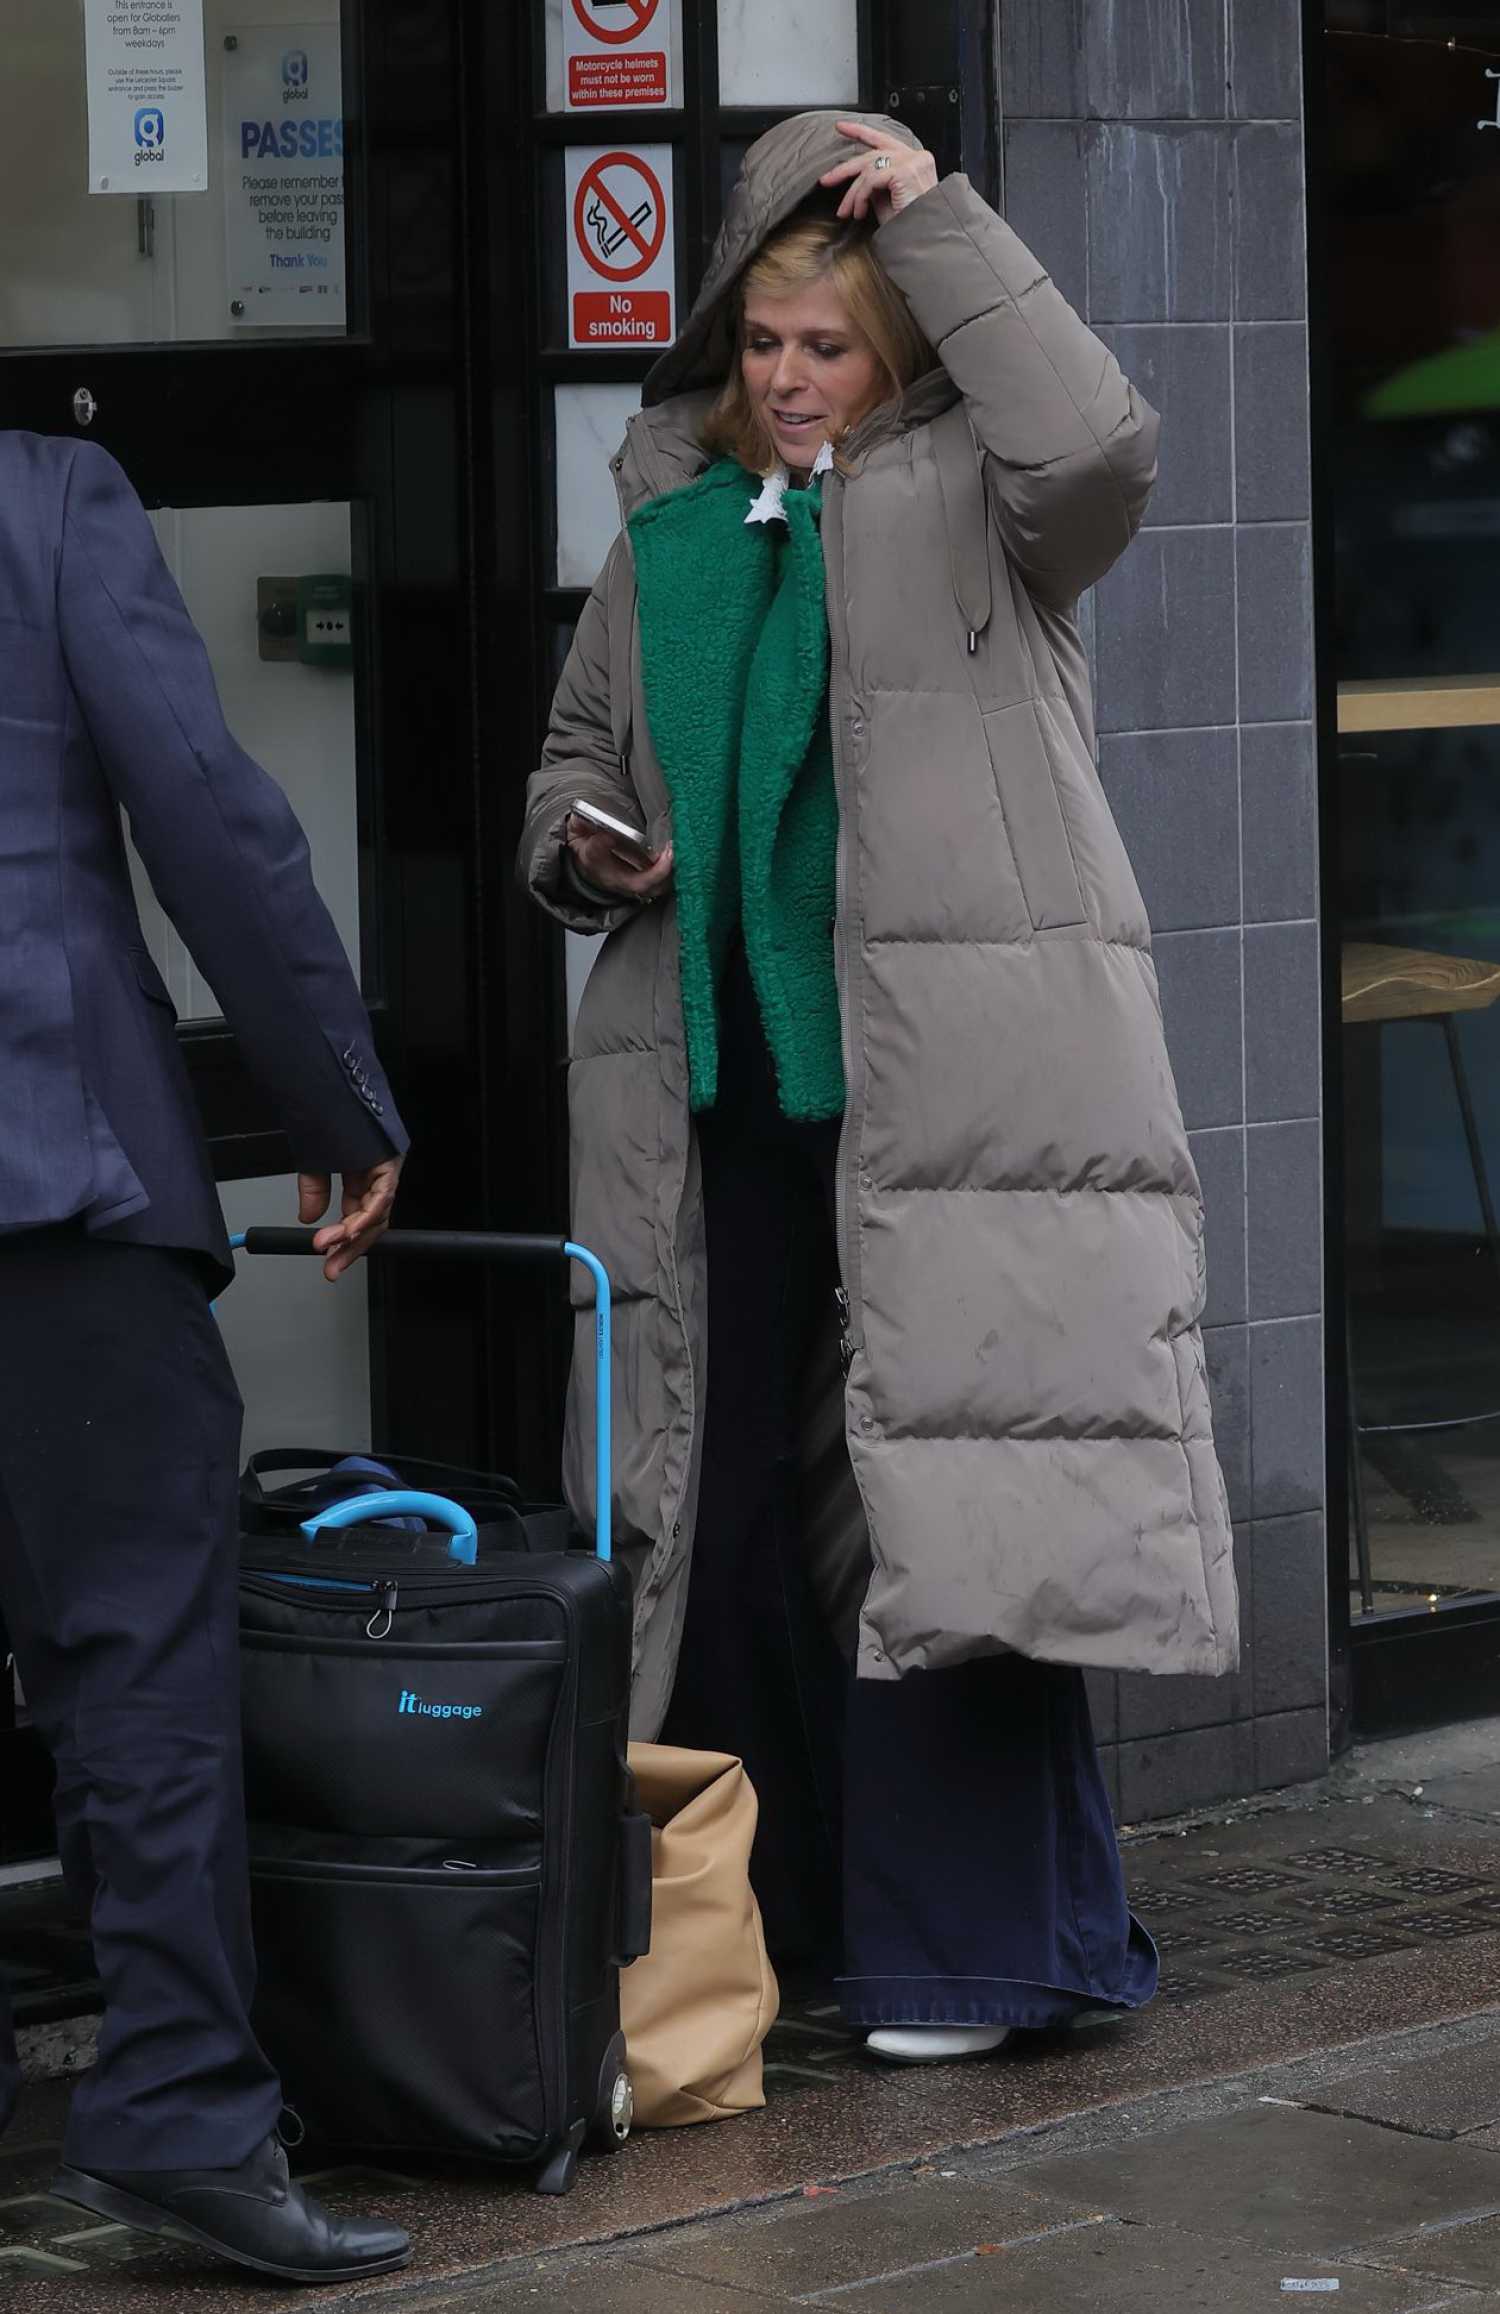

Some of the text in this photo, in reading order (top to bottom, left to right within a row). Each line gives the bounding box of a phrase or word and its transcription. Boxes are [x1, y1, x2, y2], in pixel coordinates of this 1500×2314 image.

[115, 0, 128, 9] This
[130, 0, 166, 9] entrance
[106, 14, 128, 25] open
[130, 13, 140, 21] for
[113, 26, 132, 35] from
[133, 25, 151, 35] 8am
[159, 26, 176, 36] 6pm
[124, 39, 165, 48] weekdays
[576, 58, 658, 72] Motorcycle helmets
[580, 72, 655, 85] must not be worn
[282, 88, 308, 104] global
[572, 86, 664, 99] within these premises
[133, 149, 164, 167] global
[241, 175, 278, 189] Please
[280, 174, 338, 189] remember
[249, 193, 292, 207] remove
[293, 192, 318, 208] your
[258, 208, 338, 226] before leaving
[265, 225, 331, 242] the building
[270, 253, 328, 268] Thank You
[609, 295, 632, 314] No
[588, 317, 655, 340] smoking
[398, 1689, 482, 1719] it luggage
